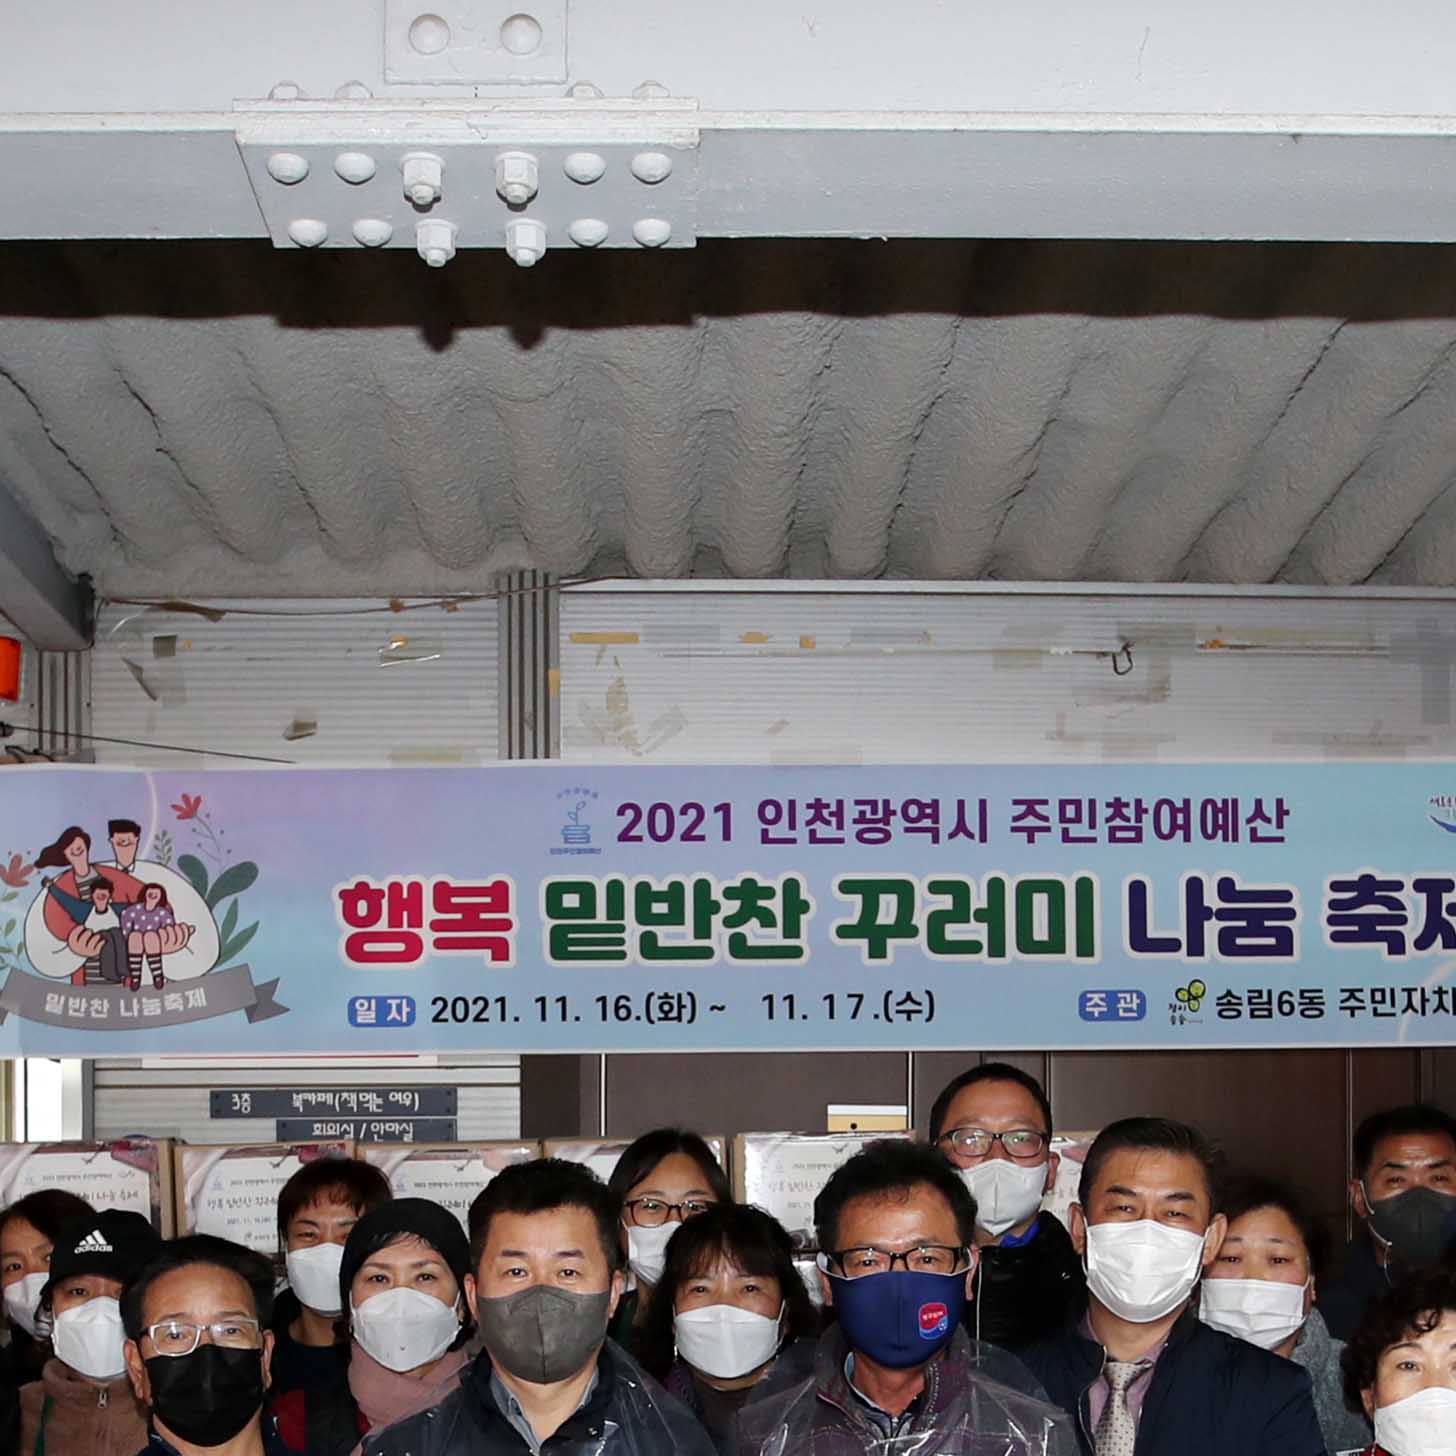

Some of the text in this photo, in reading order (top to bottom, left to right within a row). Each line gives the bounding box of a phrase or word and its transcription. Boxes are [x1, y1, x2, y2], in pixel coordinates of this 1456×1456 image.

[616, 795, 1290, 846] 2021 인천광역시 주민참여예산
[340, 878, 512, 962] 행복
[548, 876, 811, 961] 밑반찬
[837, 875, 1095, 958] 꾸러미
[1128, 874, 1297, 957] 나눔
[44, 991, 110, 1019] 밑반찬
[431, 996, 520, 1024] 2021.
[535, 996, 581, 1023] 11.
[595, 993, 698, 1026] 16.(화)
[763, 996, 808, 1021] 11.
[1215, 988, 1326, 1020] 송림6동
[232, 1093, 251, 1113] 3층
[312, 1122, 354, 1141] 회의실
[74, 1244, 113, 1254] adidas
